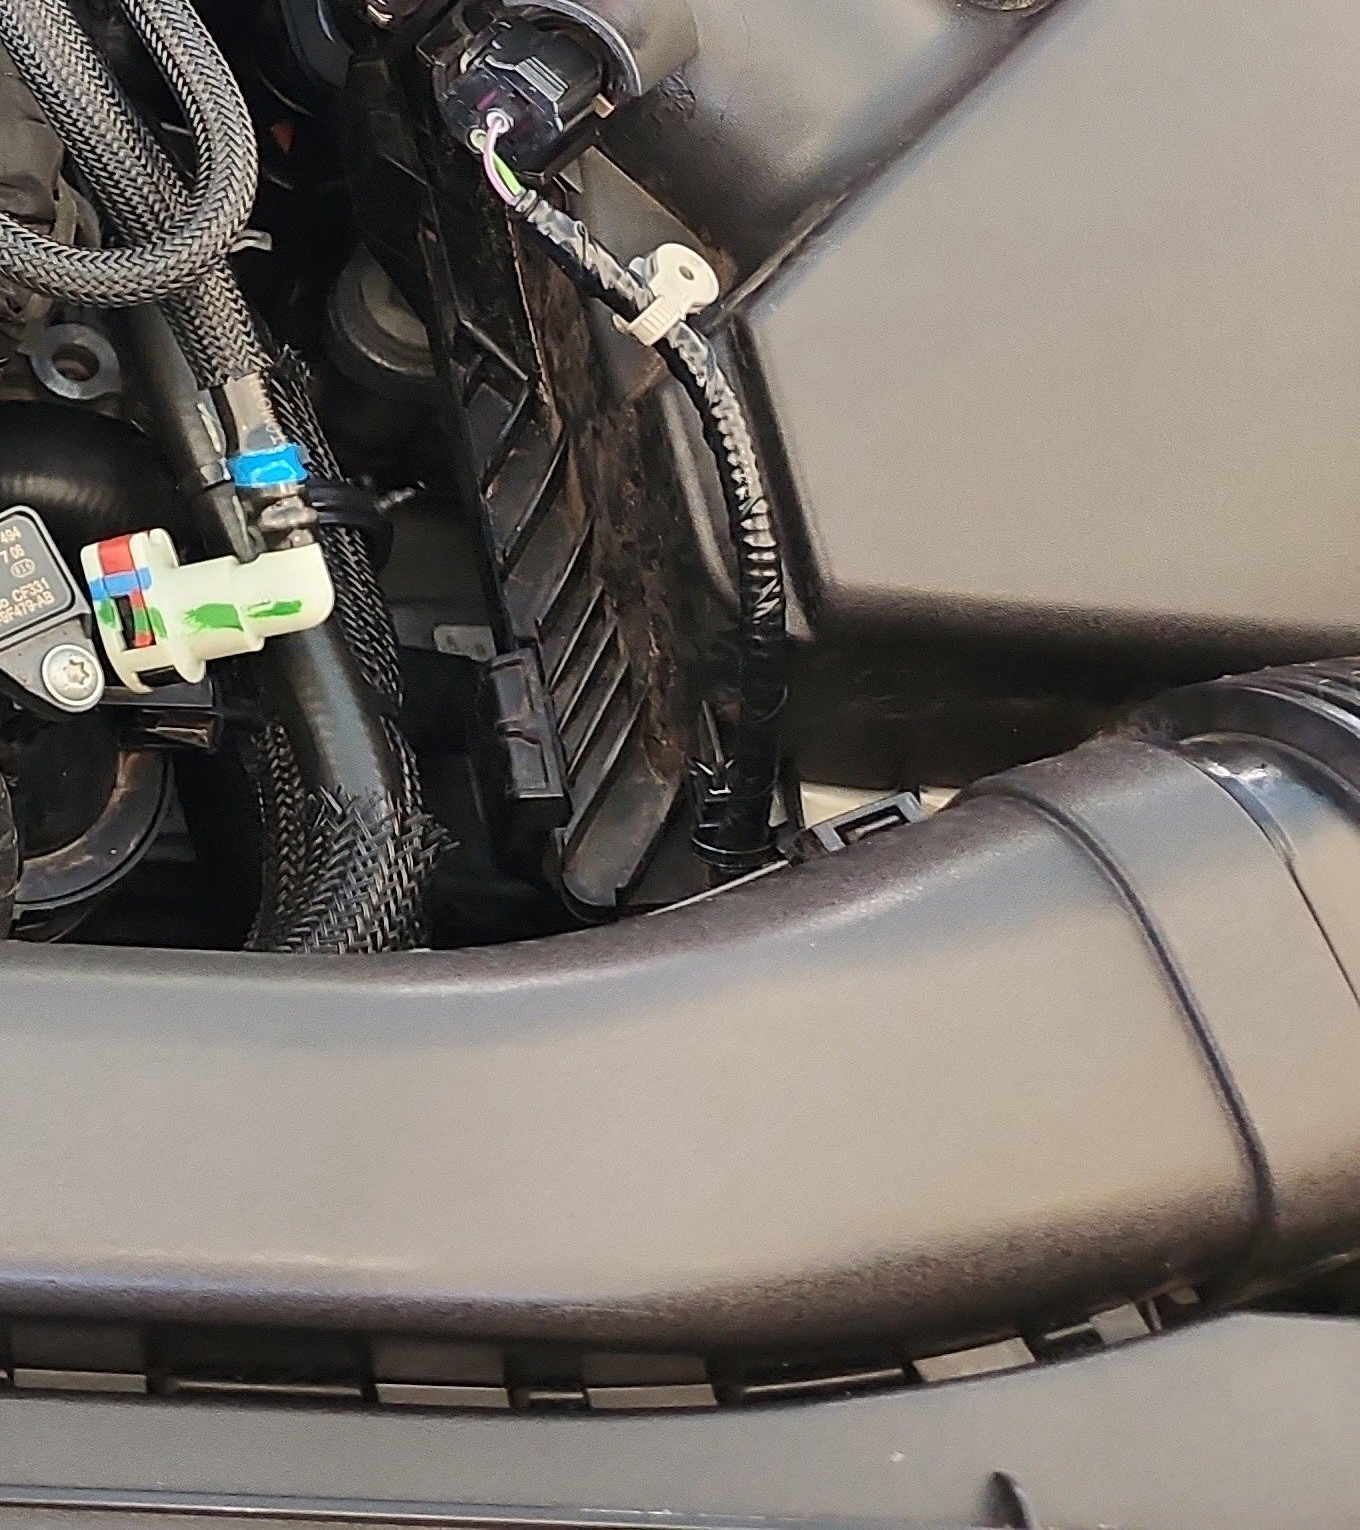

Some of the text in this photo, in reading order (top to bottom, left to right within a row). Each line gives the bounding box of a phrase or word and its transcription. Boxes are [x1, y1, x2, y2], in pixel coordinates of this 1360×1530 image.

[0, 550, 11, 564] 7
[8, 542, 25, 560] 06
[10, 575, 49, 604] CF331
